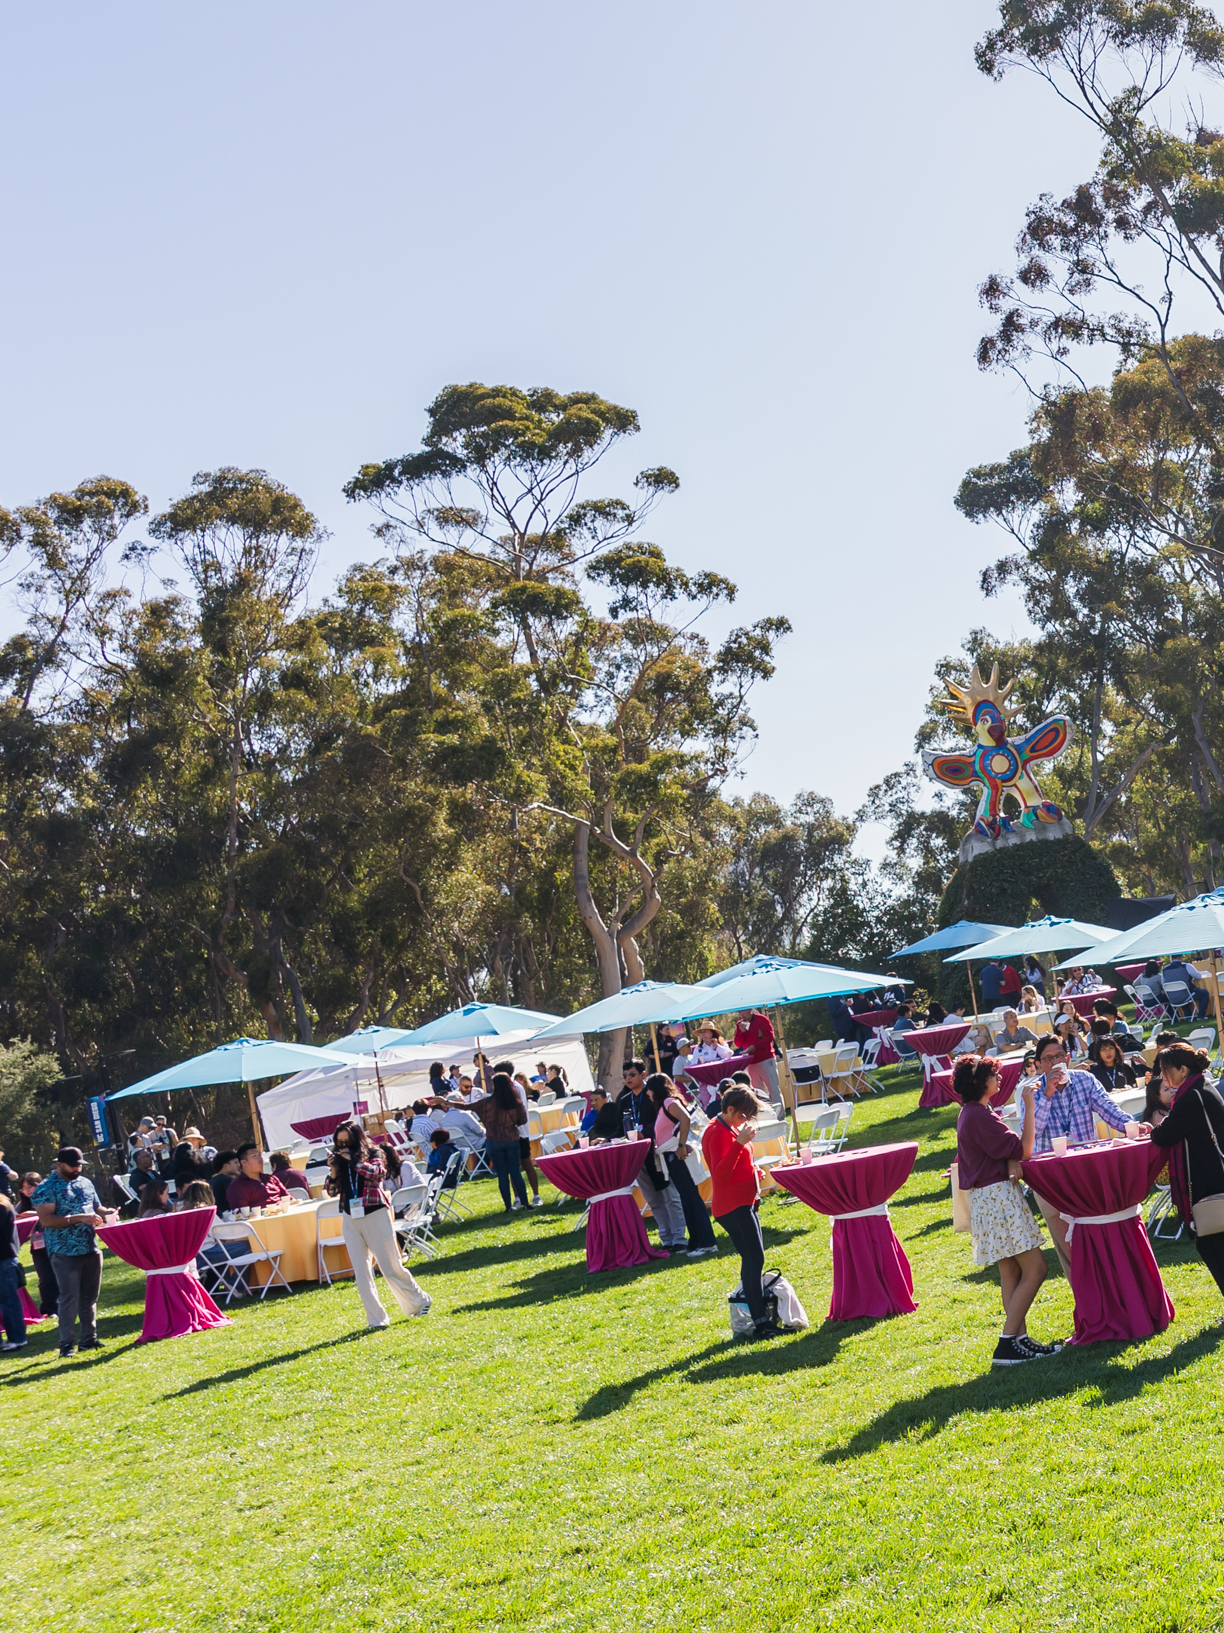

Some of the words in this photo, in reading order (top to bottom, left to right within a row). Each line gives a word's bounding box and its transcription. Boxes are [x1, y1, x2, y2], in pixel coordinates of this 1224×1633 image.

[91, 1102, 100, 1120] DIEGO
[94, 1120, 102, 1133] SAN
[96, 1133, 104, 1142] UC
